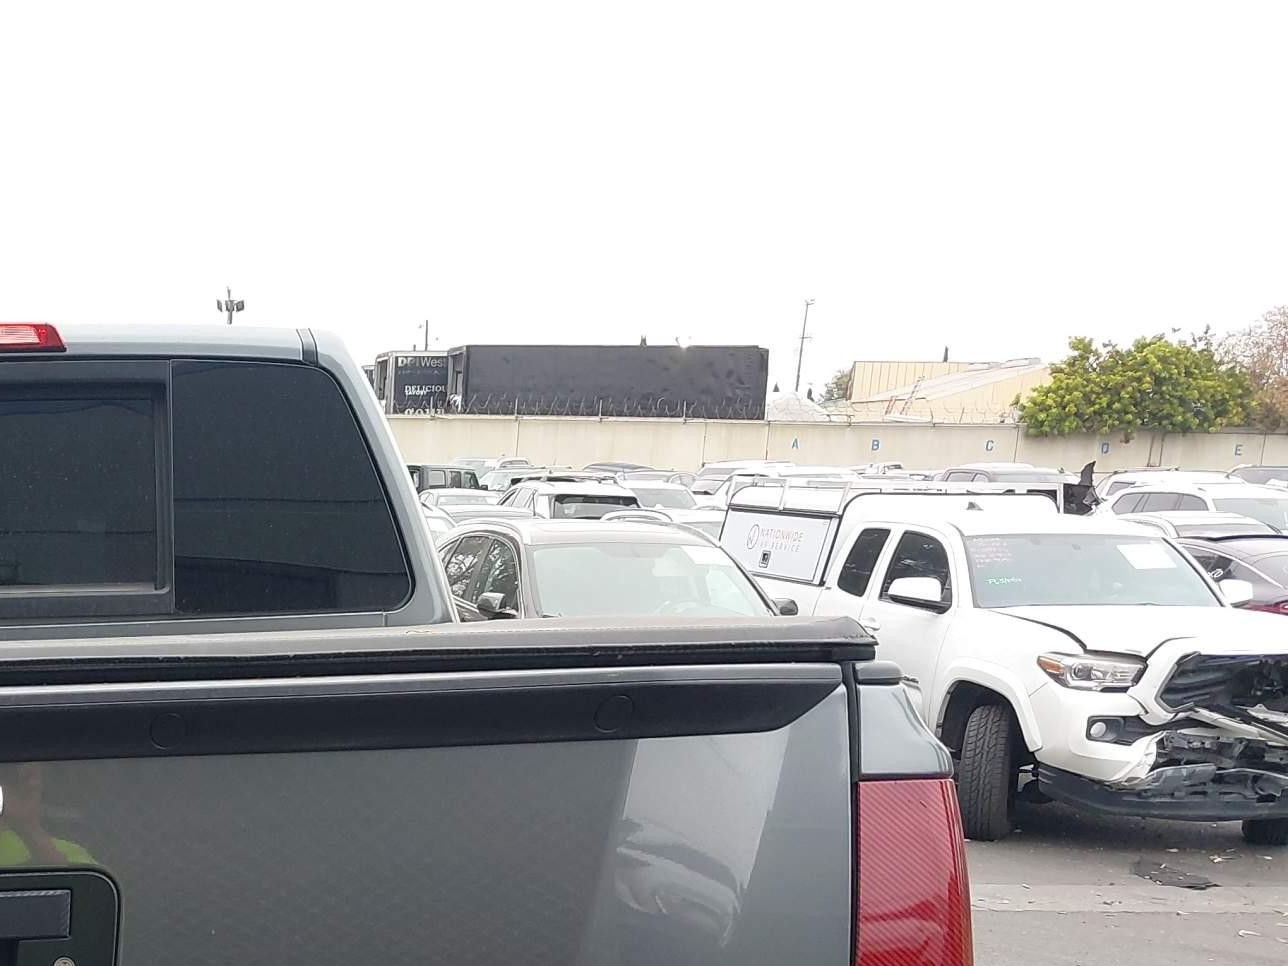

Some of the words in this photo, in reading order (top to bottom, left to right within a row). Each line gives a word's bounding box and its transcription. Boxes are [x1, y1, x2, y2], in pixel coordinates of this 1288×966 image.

[791, 438, 799, 449] A
[871, 439, 880, 451] B
[985, 439, 994, 451] C
[1100, 442, 1110, 454] D
[1234, 444, 1243, 456] E
